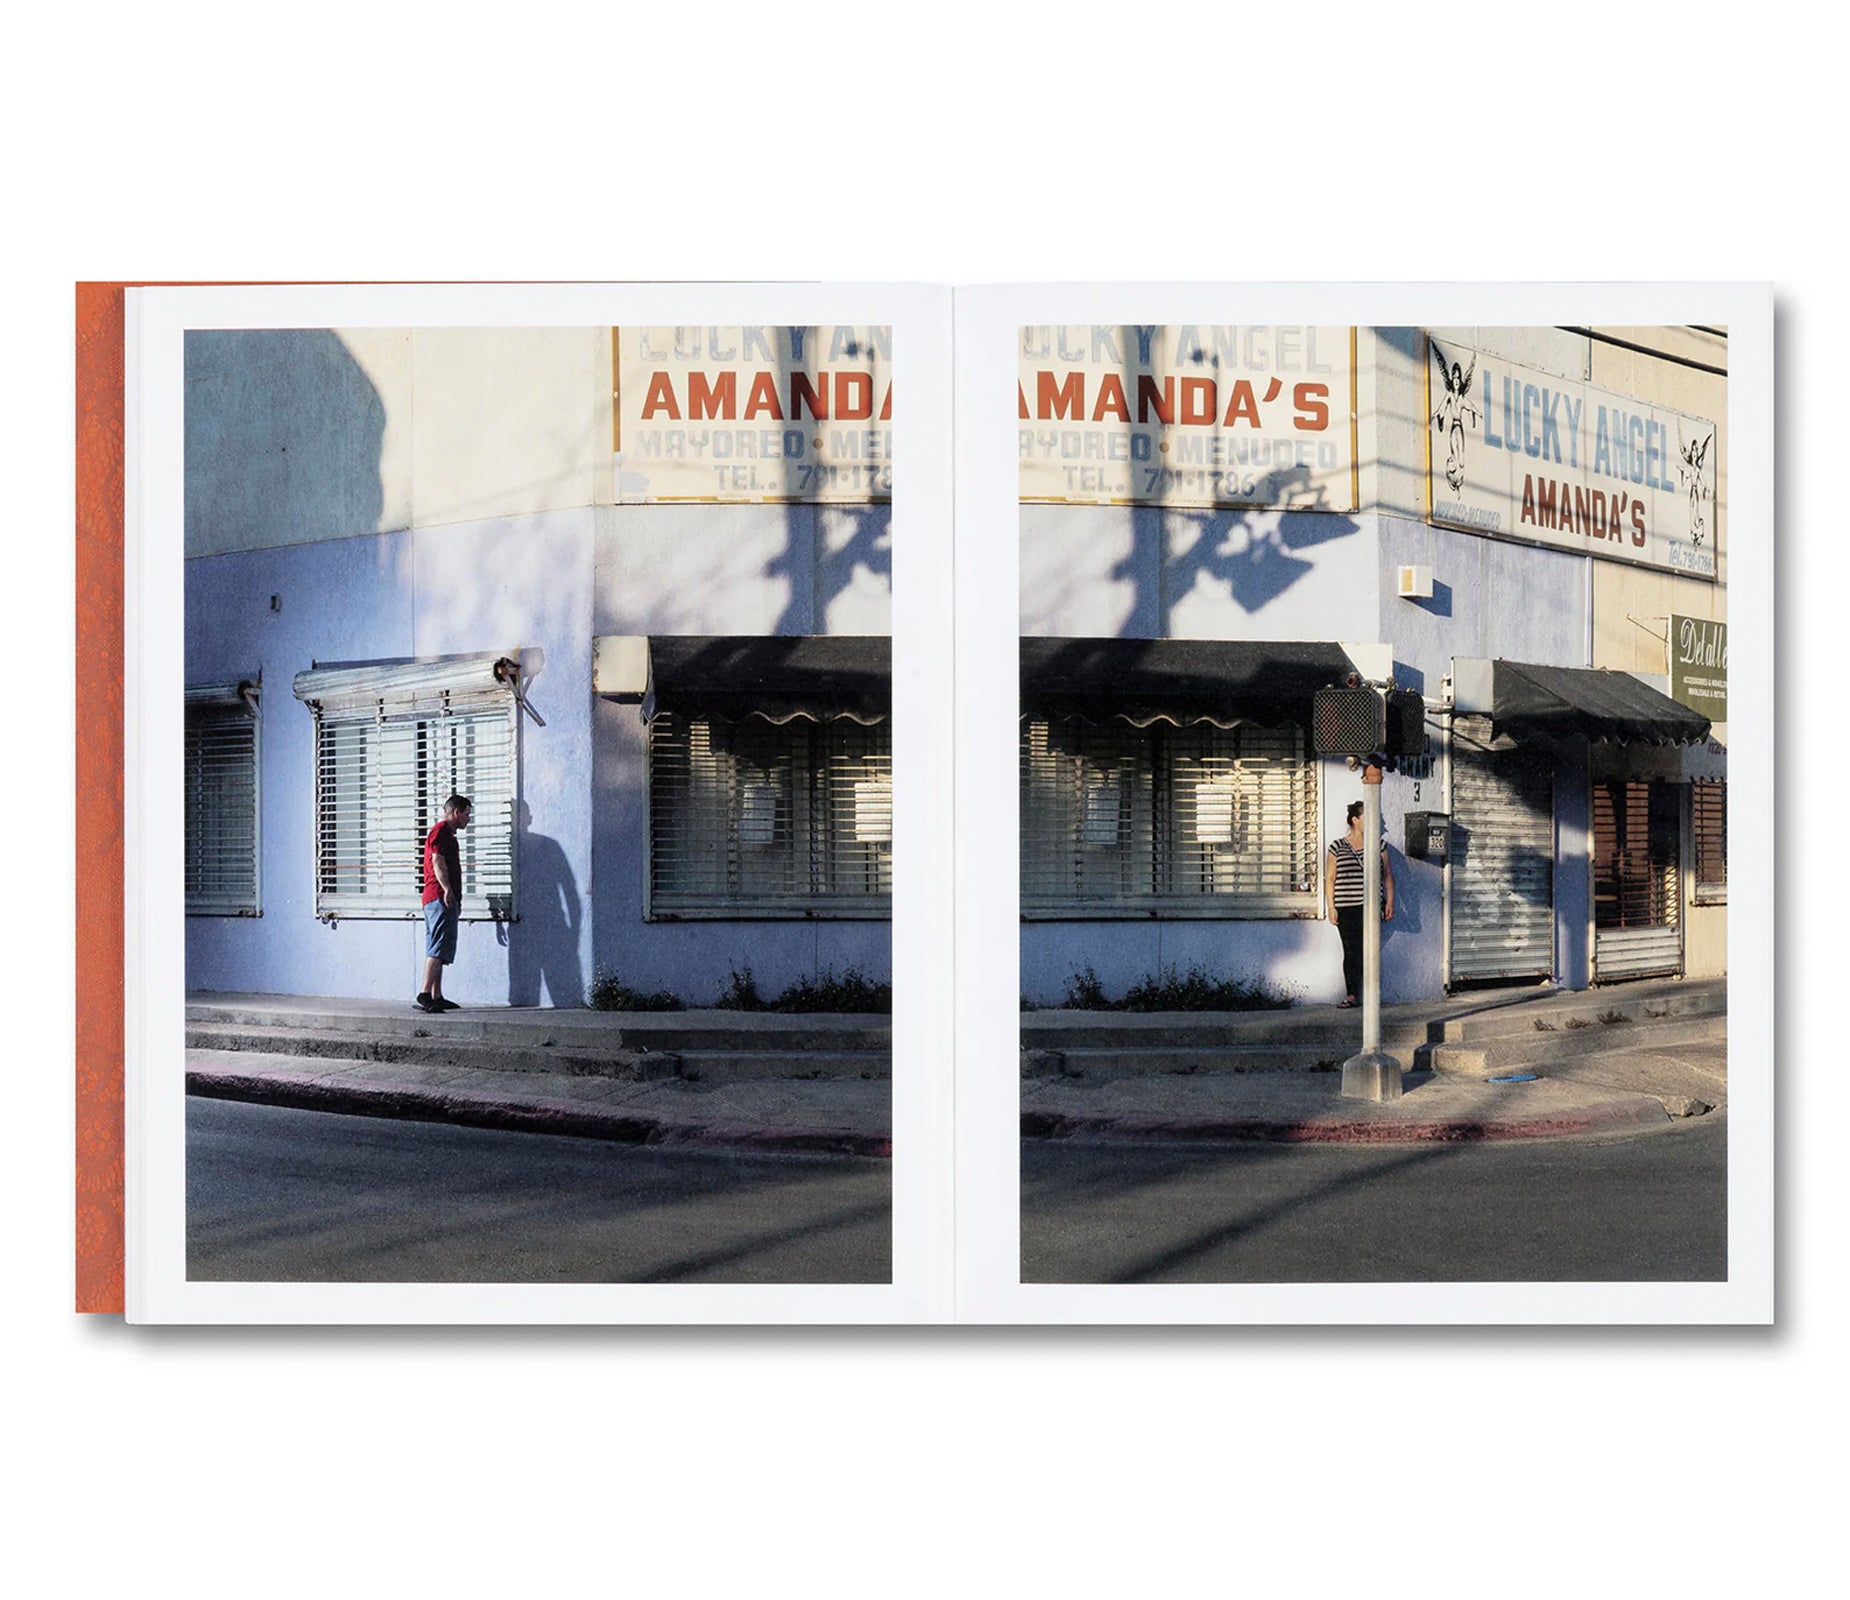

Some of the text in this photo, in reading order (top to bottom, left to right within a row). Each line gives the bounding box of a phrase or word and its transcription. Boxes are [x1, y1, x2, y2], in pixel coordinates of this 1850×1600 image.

[1175, 326, 1331, 374] ANGEL
[636, 430, 805, 459] MAYOREO
[1482, 369, 1675, 493] LUCKY ANGEL
[1176, 436, 1337, 469] MENUDEO
[714, 465, 777, 491] TEL.
[1062, 465, 1125, 492] TEL.
[1520, 474, 1646, 548] AMANDA'S
[1413, 781, 1420, 802] 3
